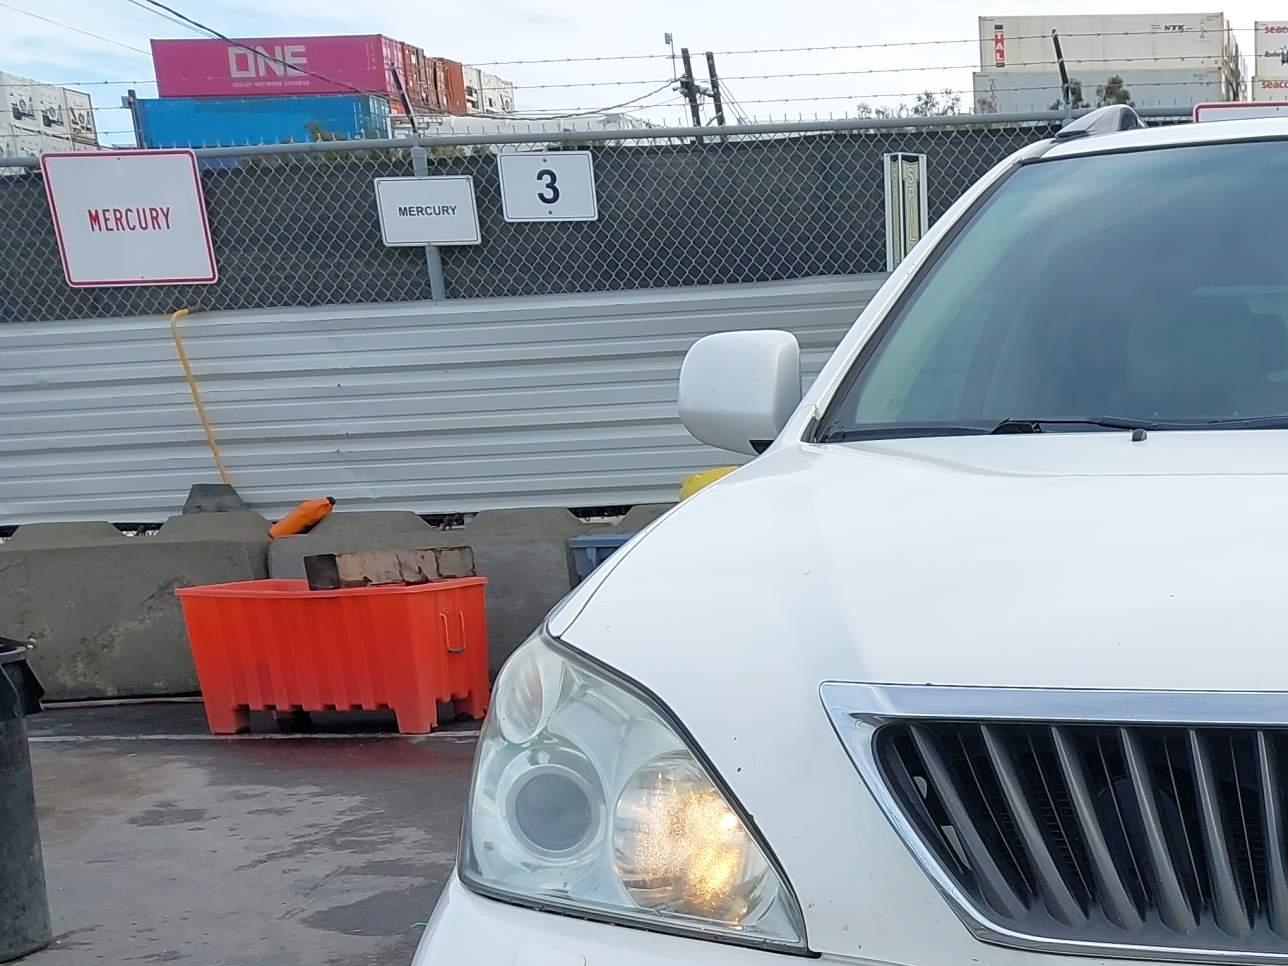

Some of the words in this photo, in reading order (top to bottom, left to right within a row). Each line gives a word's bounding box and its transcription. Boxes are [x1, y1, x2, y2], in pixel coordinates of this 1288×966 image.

[228, 45, 308, 78] ONE
[536, 169, 560, 205] 3
[87, 207, 171, 232] MERCURY
[398, 205, 458, 217] MERCURY
